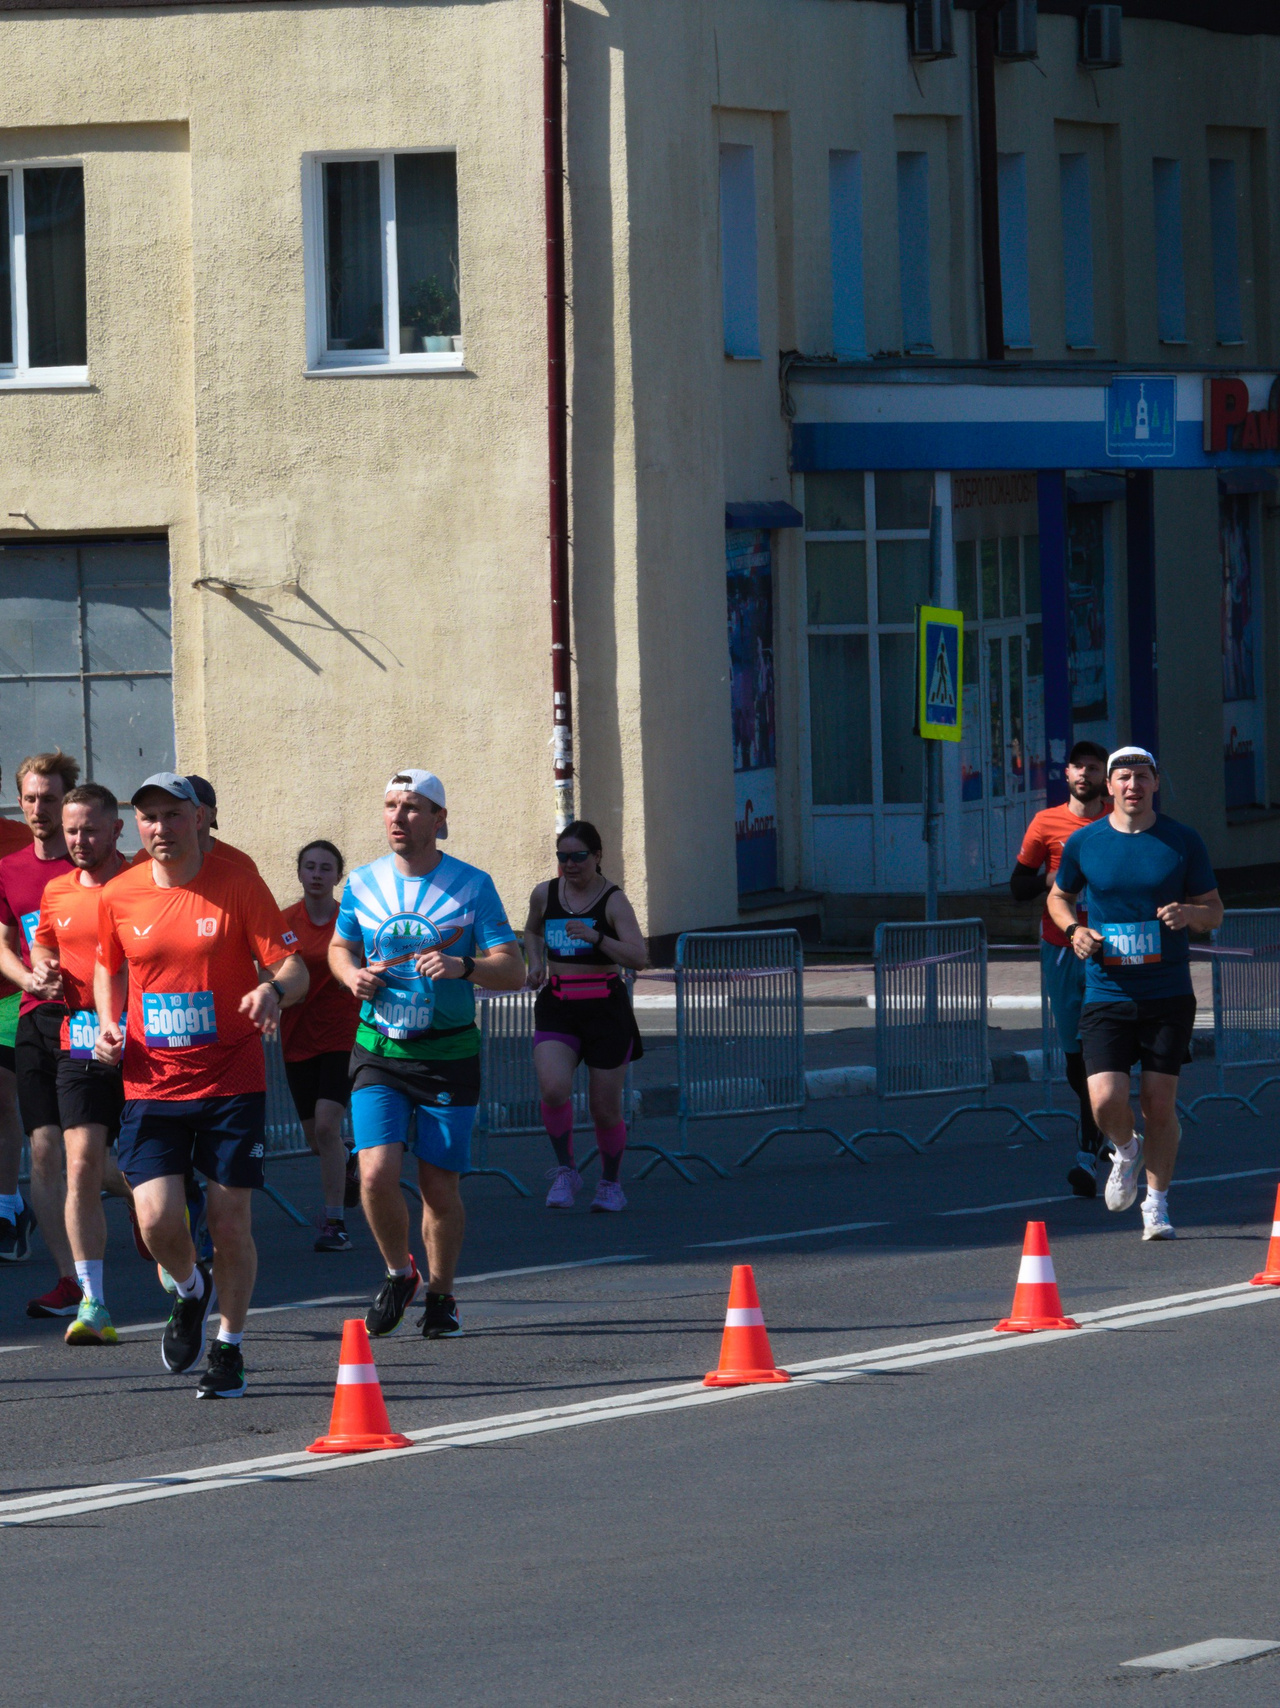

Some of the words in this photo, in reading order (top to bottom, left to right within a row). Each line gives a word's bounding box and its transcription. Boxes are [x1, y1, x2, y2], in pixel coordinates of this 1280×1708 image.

[1204, 376, 1280, 452] РАМ
[195, 917, 217, 937] 10
[1109, 933, 1153, 955] 70141
[148, 1007, 210, 1035] 50091
[374, 1000, 430, 1029] 50006
[167, 1035, 192, 1047] 10KM
[387, 1027, 408, 1039] 10KM
